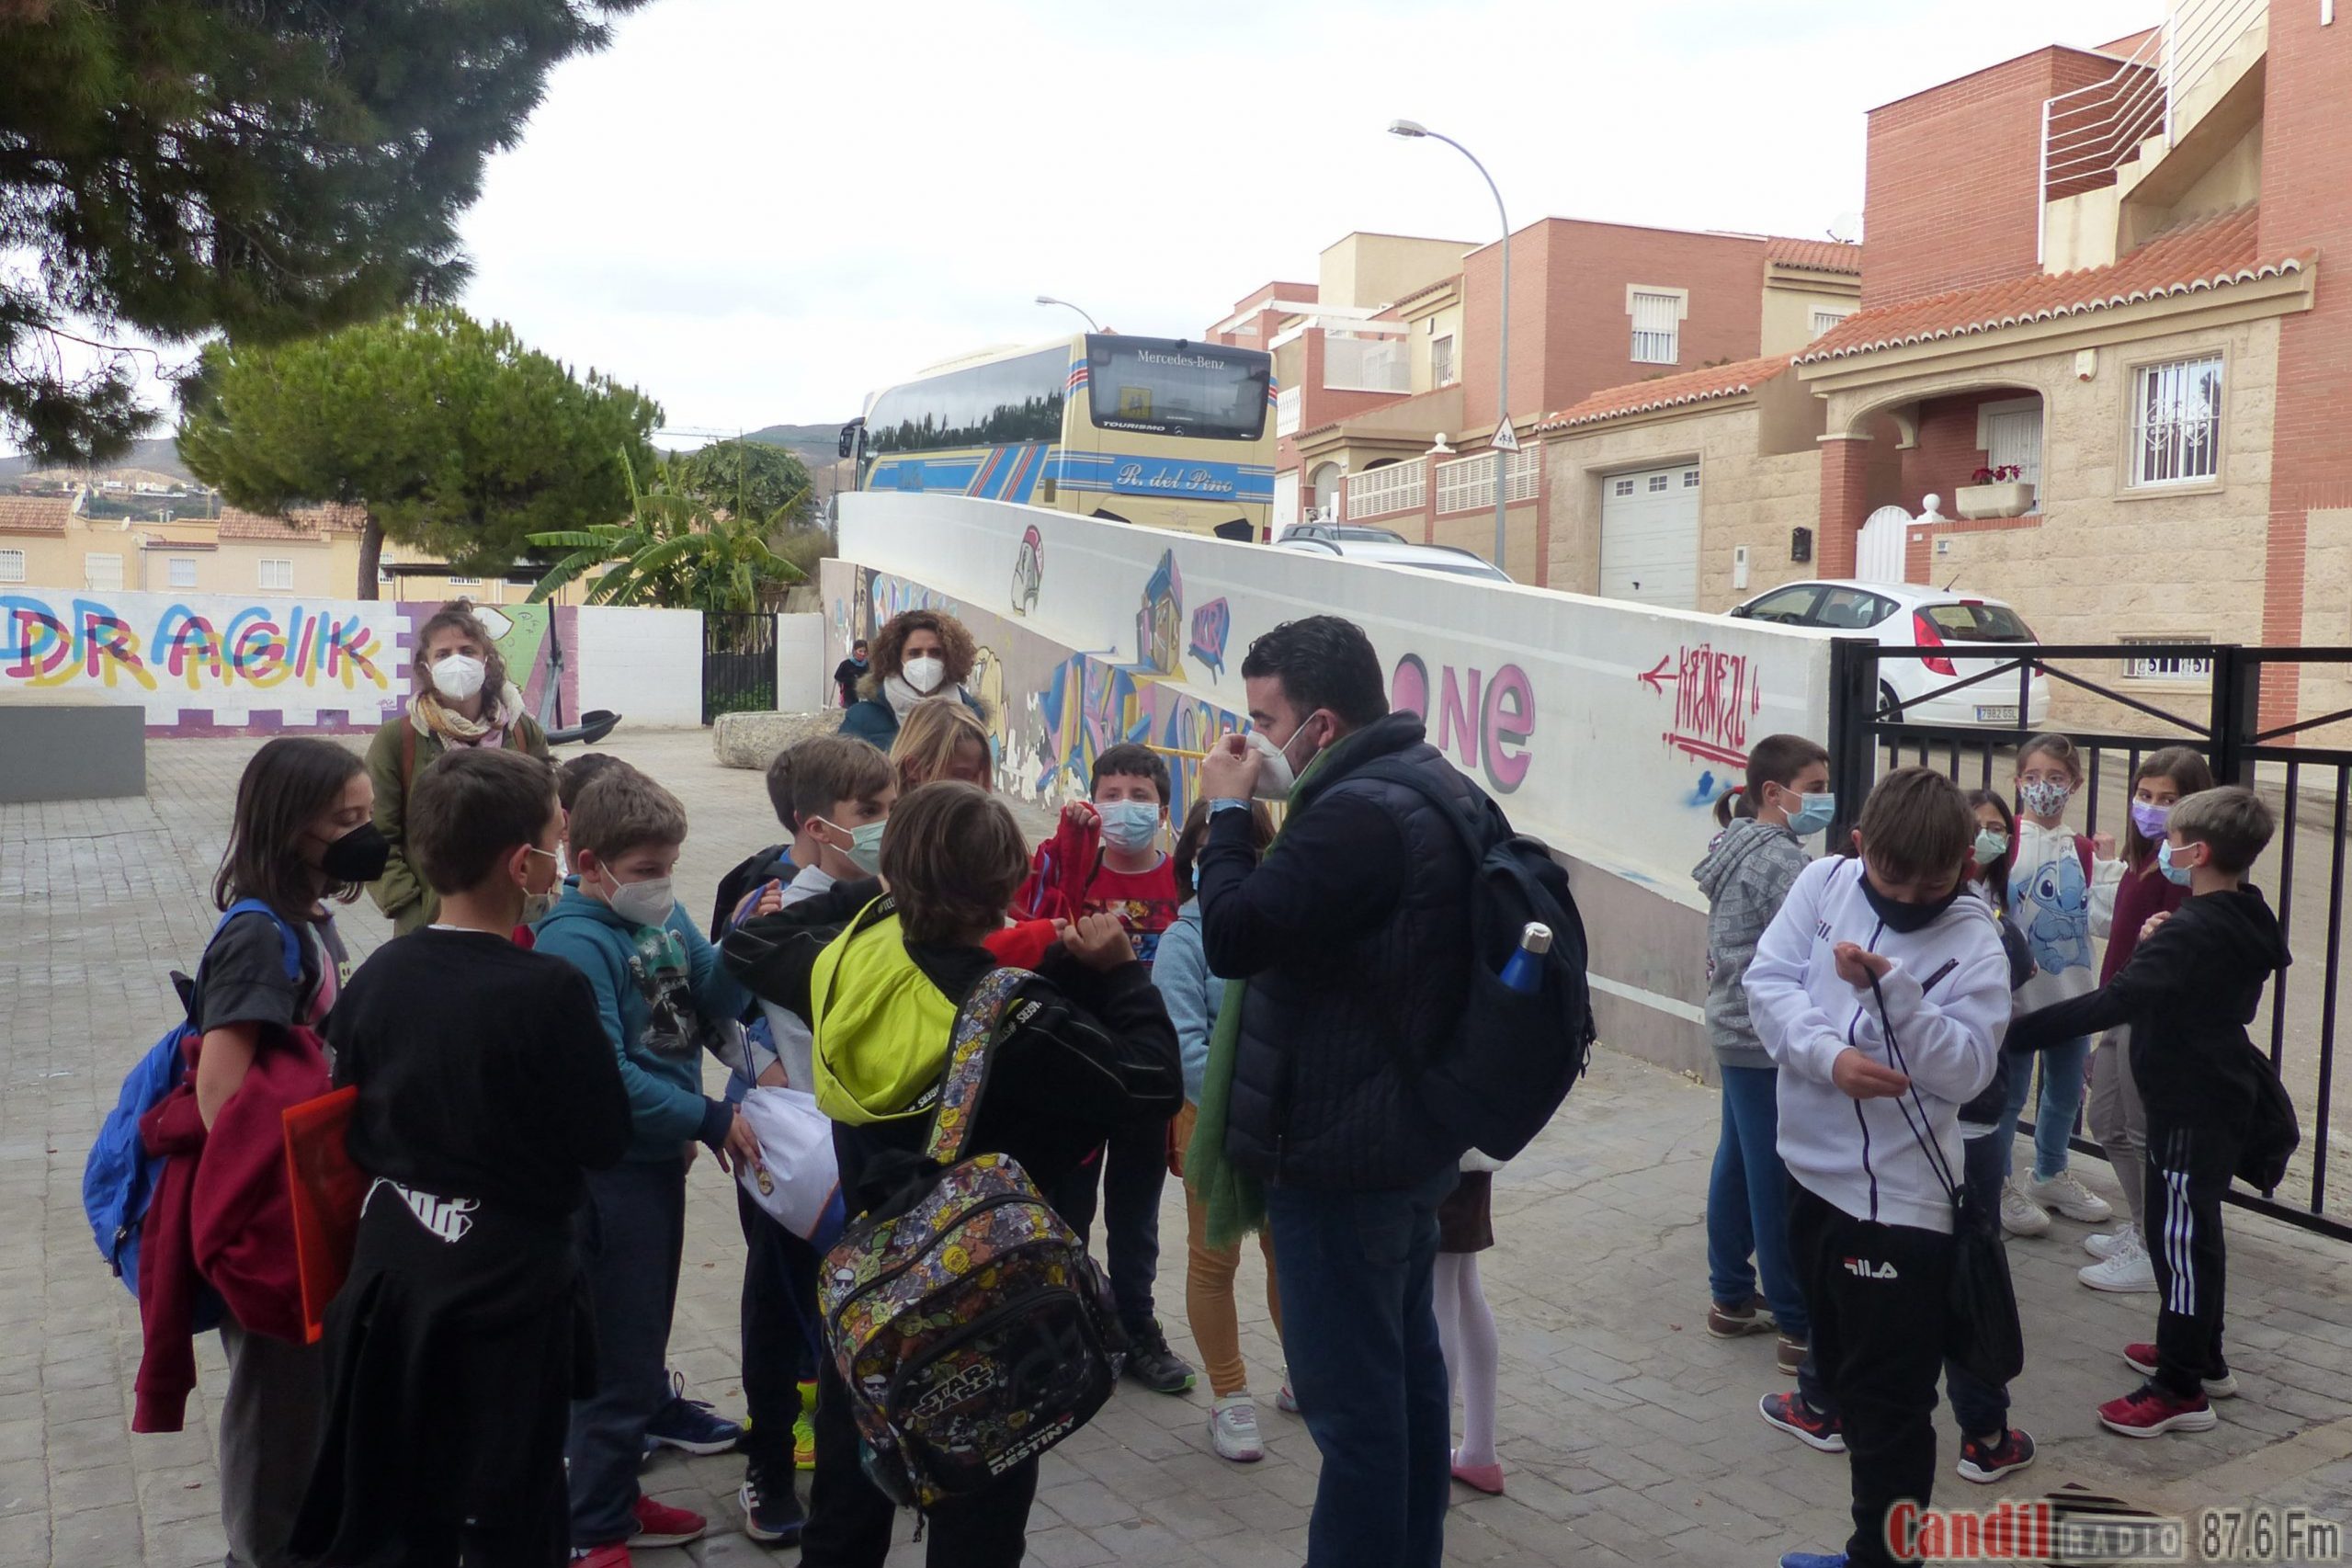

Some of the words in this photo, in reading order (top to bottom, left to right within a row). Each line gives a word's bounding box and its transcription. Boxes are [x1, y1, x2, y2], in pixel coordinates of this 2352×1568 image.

[1137, 349, 1225, 370] Mercedes-Benz
[1103, 420, 1166, 432] TOURISMO
[1116, 462, 1143, 486] R.
[1149, 467, 1185, 490] del
[1185, 469, 1234, 494] Pino
[1844, 1256, 1898, 1278] FILA
[912, 1364, 994, 1414] STAR
[912, 1372, 994, 1419] WARS
[989, 1416, 1074, 1476] DESTINY
